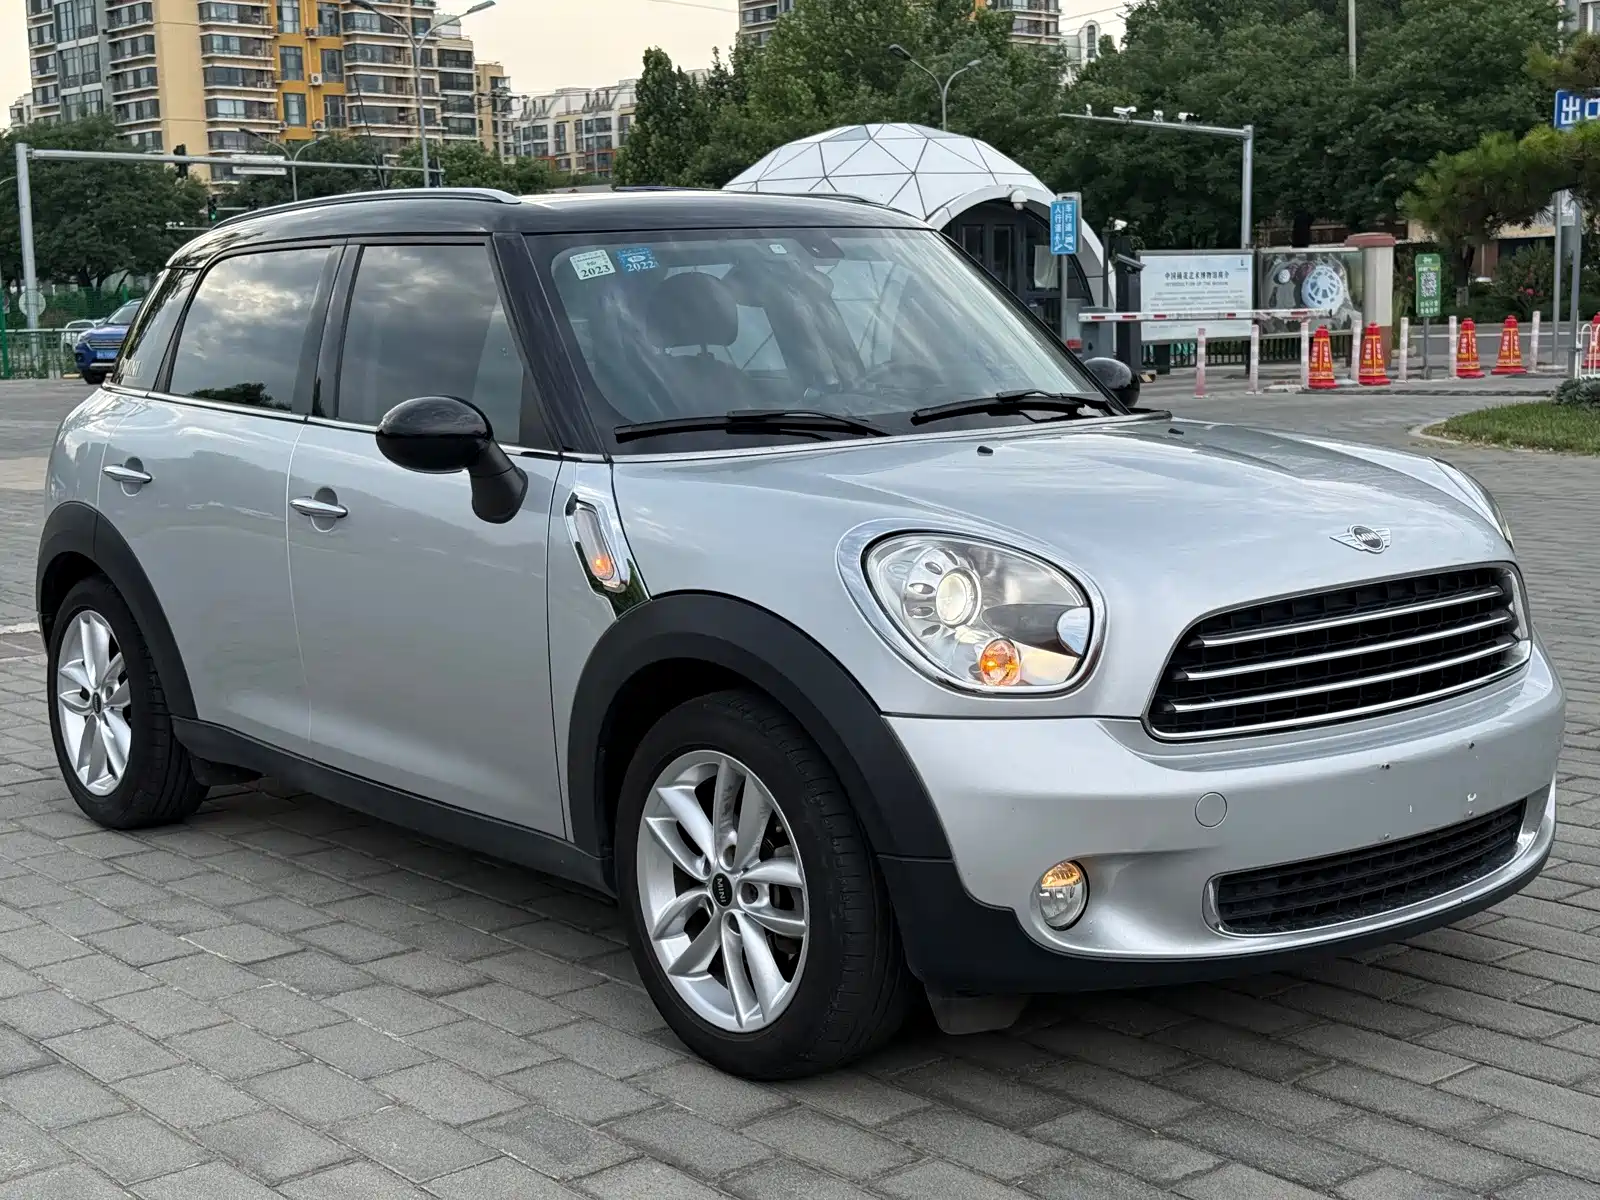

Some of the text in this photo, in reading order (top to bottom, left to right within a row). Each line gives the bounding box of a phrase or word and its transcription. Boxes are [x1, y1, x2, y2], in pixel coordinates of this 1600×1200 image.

[1561, 96, 1600, 125] 出口
[580, 264, 611, 278] 2023
[626, 260, 656, 273] 2022
[1356, 532, 1379, 542] MINI
[716, 878, 727, 903] MINI
